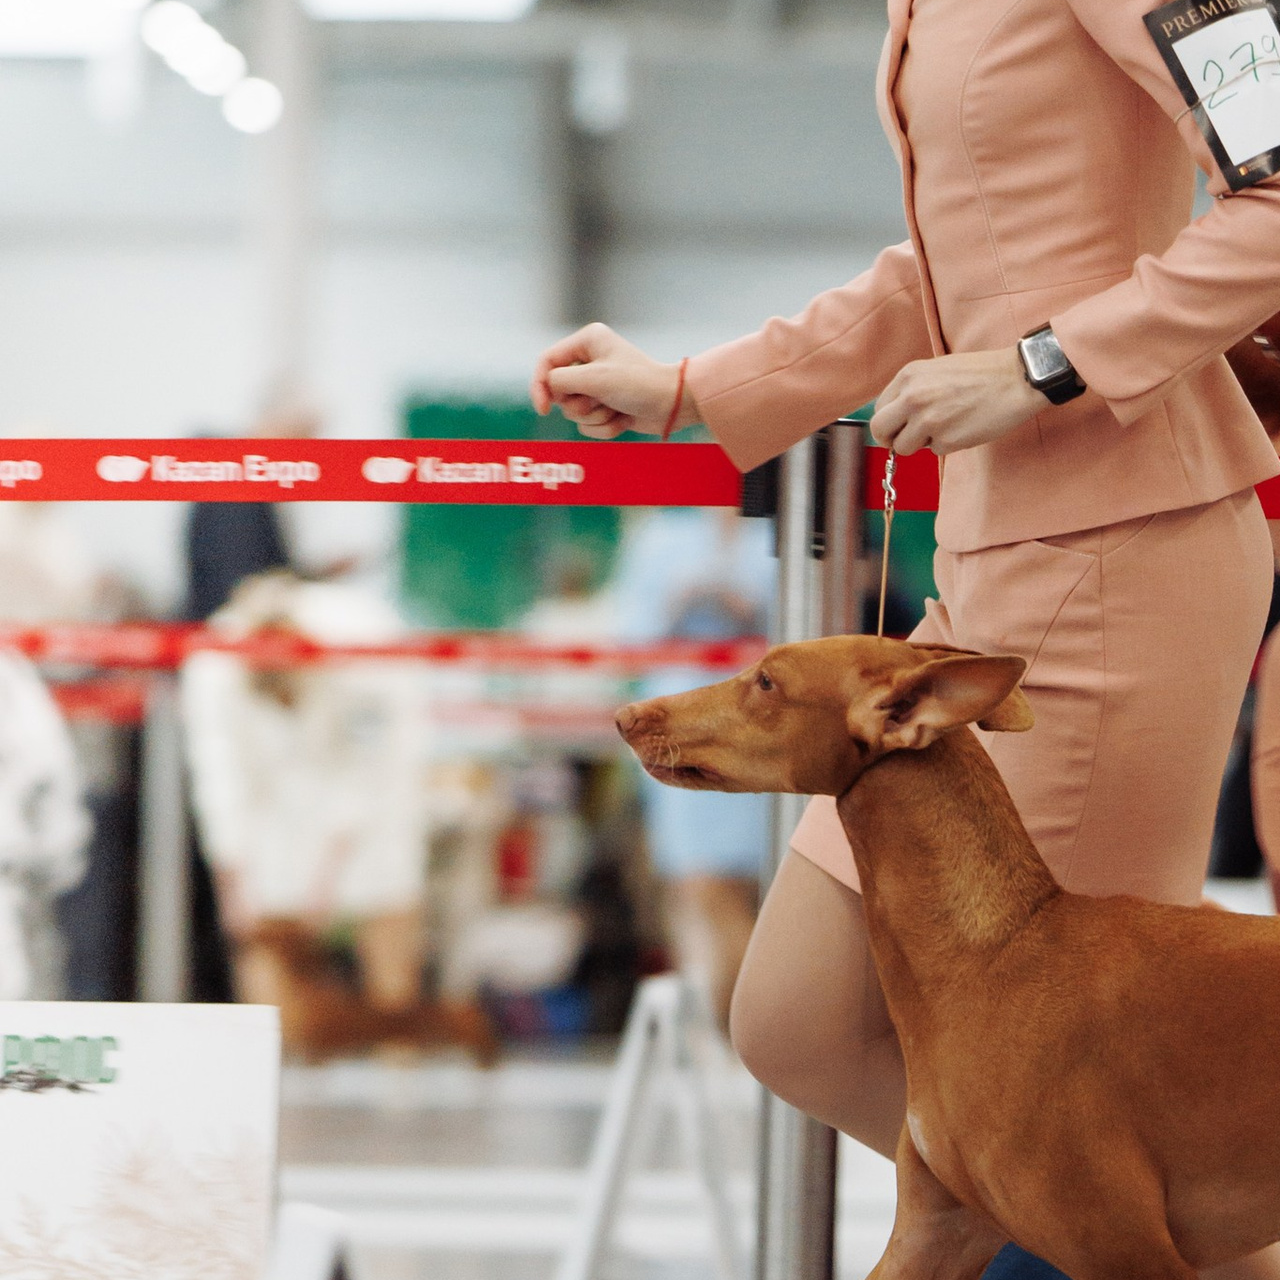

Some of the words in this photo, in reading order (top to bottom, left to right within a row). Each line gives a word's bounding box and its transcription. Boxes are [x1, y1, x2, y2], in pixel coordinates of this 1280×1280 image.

[150, 454, 243, 483] Kazan
[243, 454, 321, 489] Expo
[416, 456, 507, 484] Kazan
[507, 456, 586, 490] Expo
